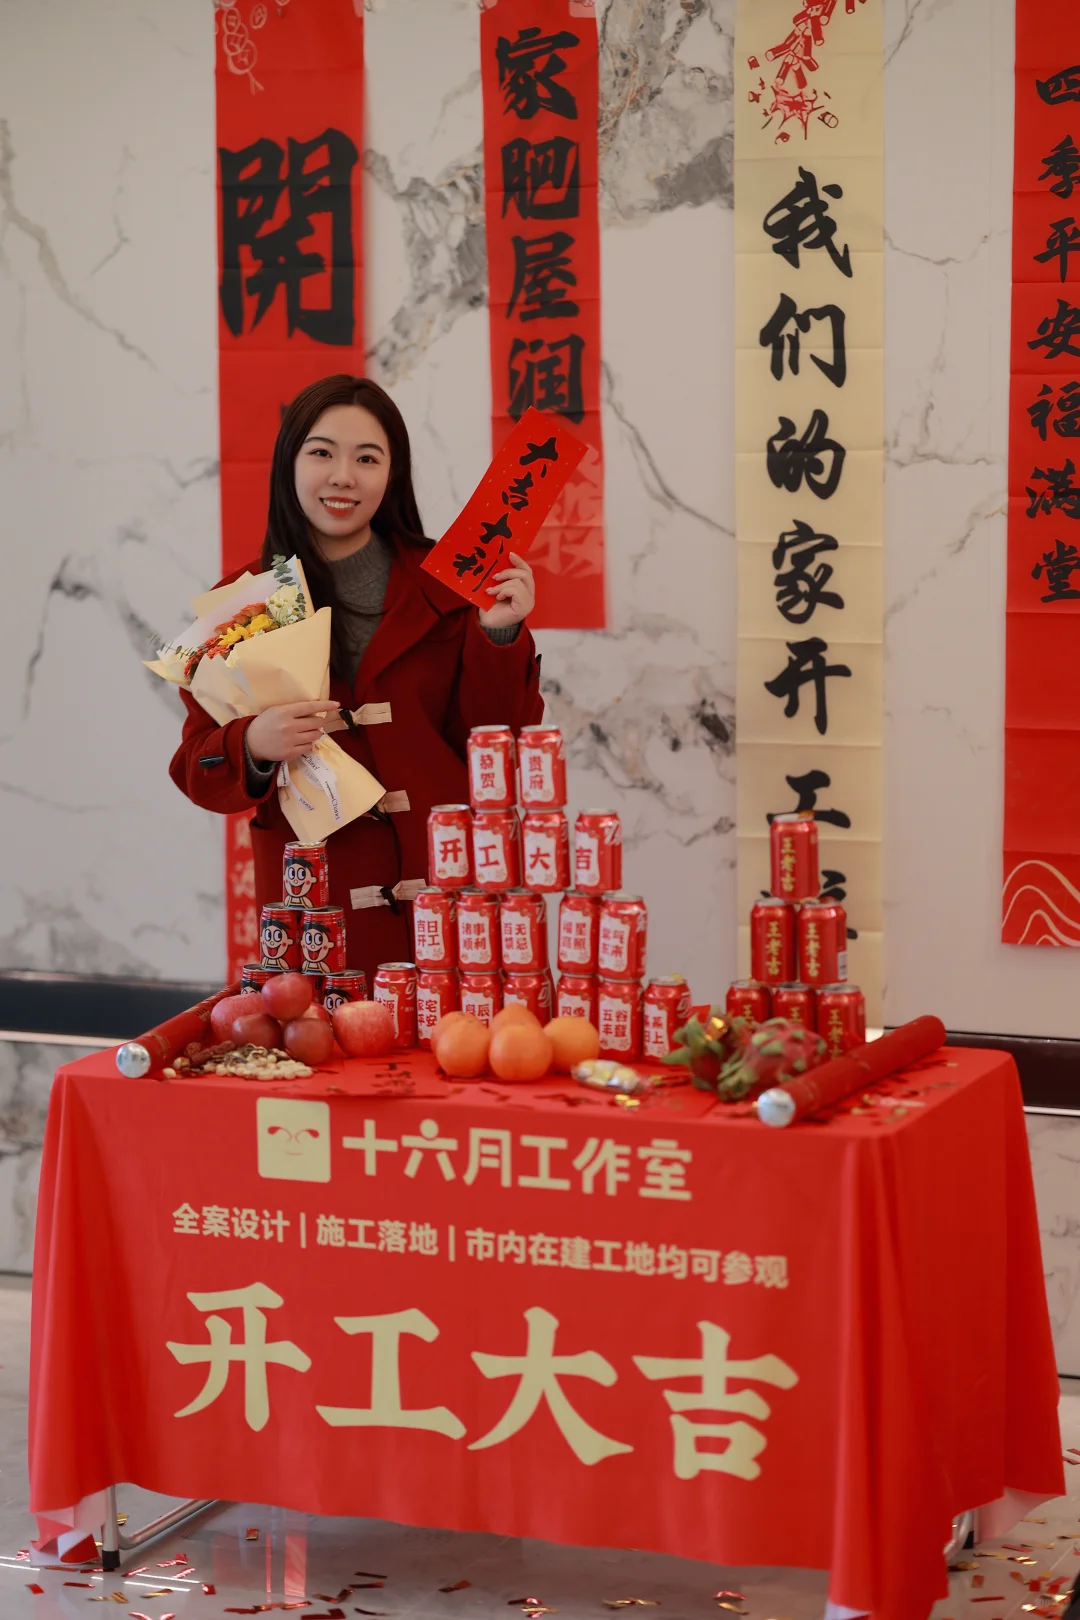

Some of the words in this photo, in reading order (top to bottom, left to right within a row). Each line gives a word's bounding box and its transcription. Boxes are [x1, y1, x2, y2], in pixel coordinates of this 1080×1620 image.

[218, 127, 359, 346] 開
[496, 27, 585, 425] 家肥屋润
[1025, 65, 1080, 604] 四季平安福满堂
[759, 166, 858, 940] 我们的家开工
[480, 753, 495, 789] 恭贺
[439, 838, 463, 863] 开
[478, 844, 499, 867] 工
[529, 846, 550, 870] 大
[575, 846, 592, 870] 吉
[417, 920, 438, 933] 吉日
[417, 934, 440, 947] 开工
[342, 1118, 692, 1201] 十六月工作室
[172, 1202, 290, 1243] 全案设计
[316, 1214, 439, 1256] 施工落地
[466, 1227, 789, 1289] 市内在建工地均可参观
[165, 1281, 799, 1481] 开工大吉
